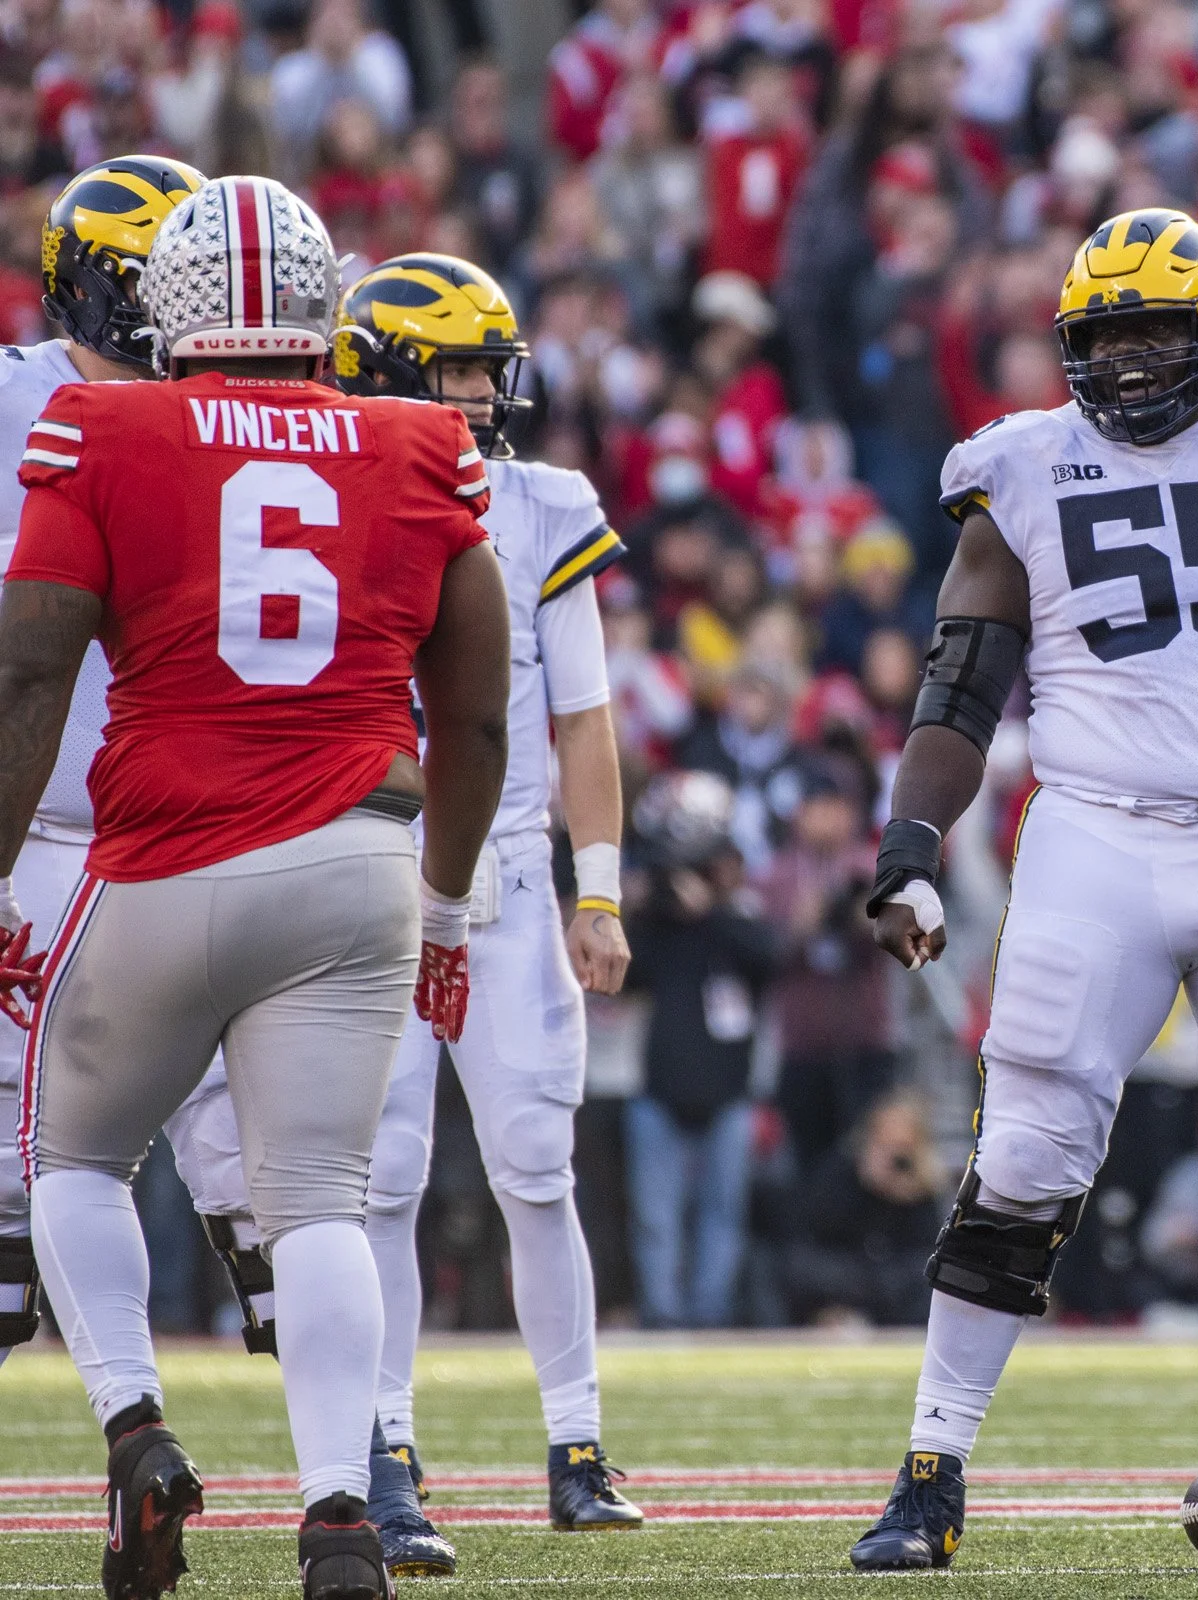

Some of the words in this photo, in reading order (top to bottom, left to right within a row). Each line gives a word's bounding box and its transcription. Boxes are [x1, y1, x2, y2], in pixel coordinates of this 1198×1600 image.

[193, 338, 312, 350] BUCKEYES
[224, 377, 306, 389] BUCKEYES
[188, 397, 361, 453] VINCENT
[217, 459, 341, 687] 6
[568, 1445, 597, 1465] M
[914, 1458, 936, 1475] M
